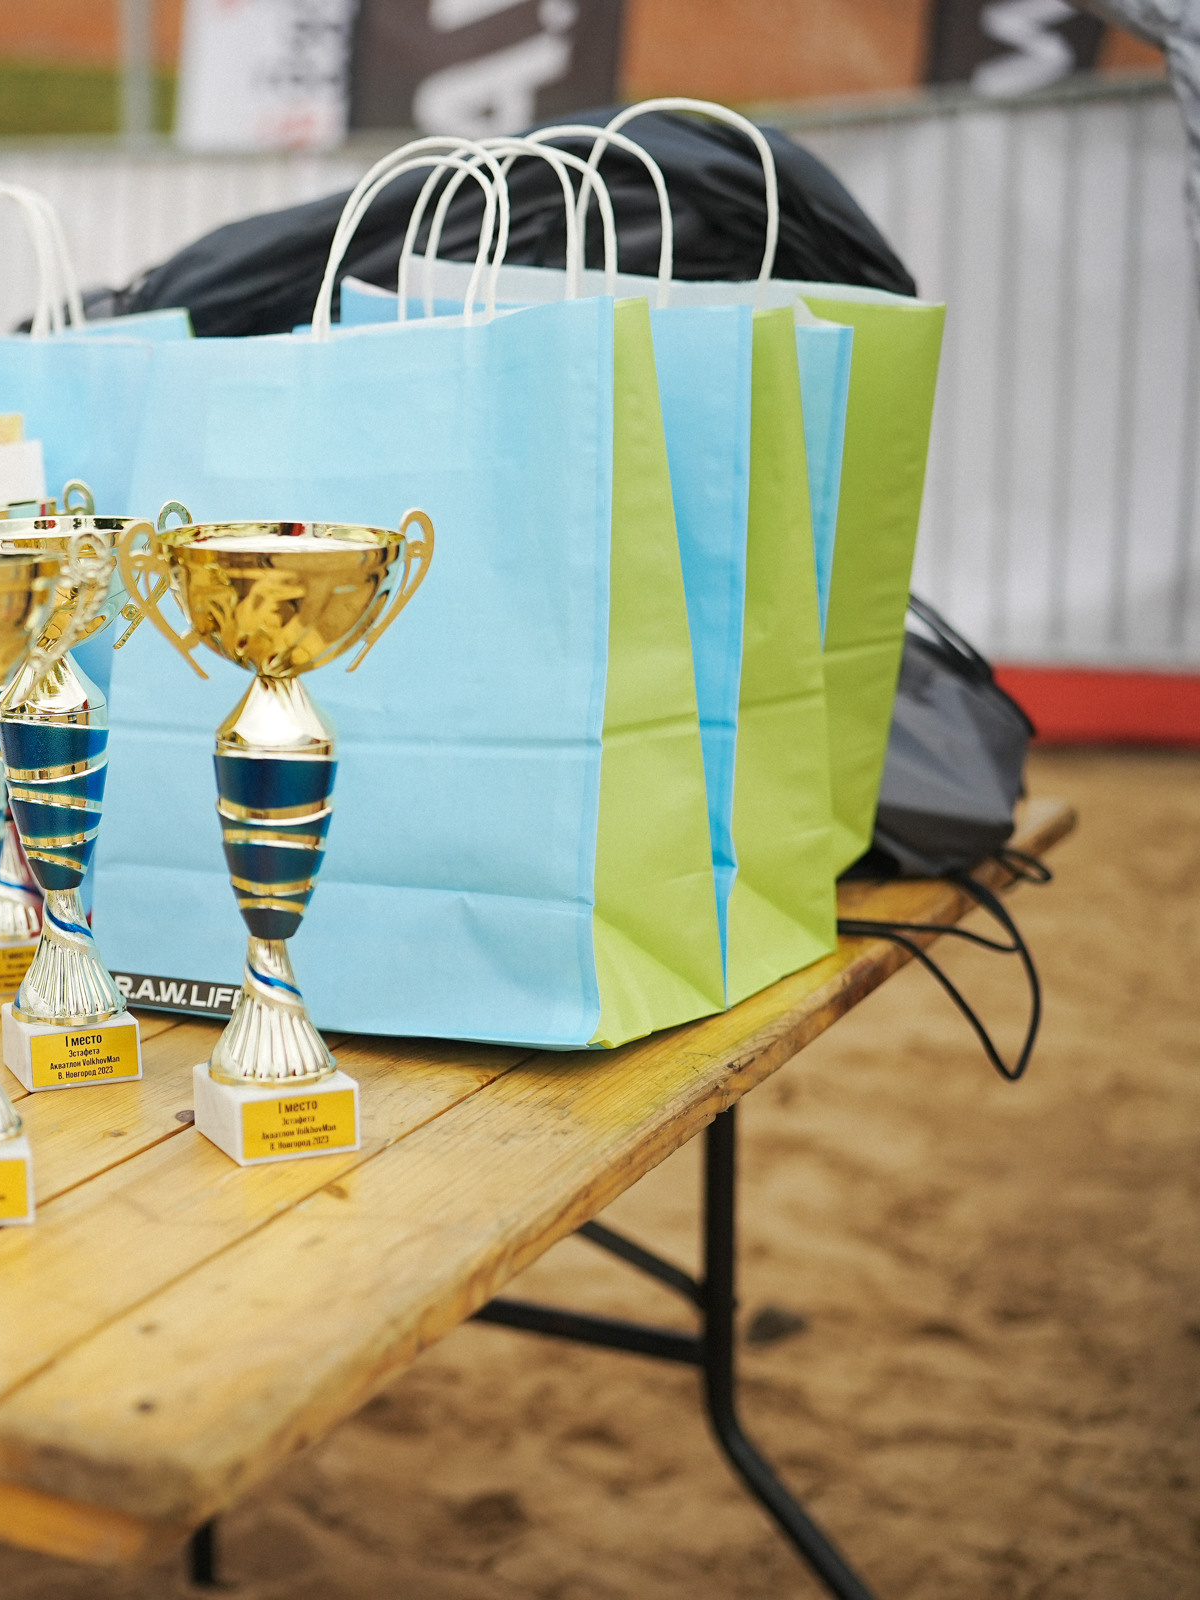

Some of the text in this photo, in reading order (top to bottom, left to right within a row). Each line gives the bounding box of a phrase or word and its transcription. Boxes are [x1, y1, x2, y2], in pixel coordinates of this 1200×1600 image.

[71, 1035, 102, 1046] место
[69, 1048, 100, 1057] Эстафета
[50, 1056, 120, 1070] Акватлон VolkhovMan
[66, 1069, 96, 1079] Новгород
[98, 1066, 113, 1075] 2023
[285, 1101, 318, 1113] место
[313, 1136, 329, 1144] 2023
